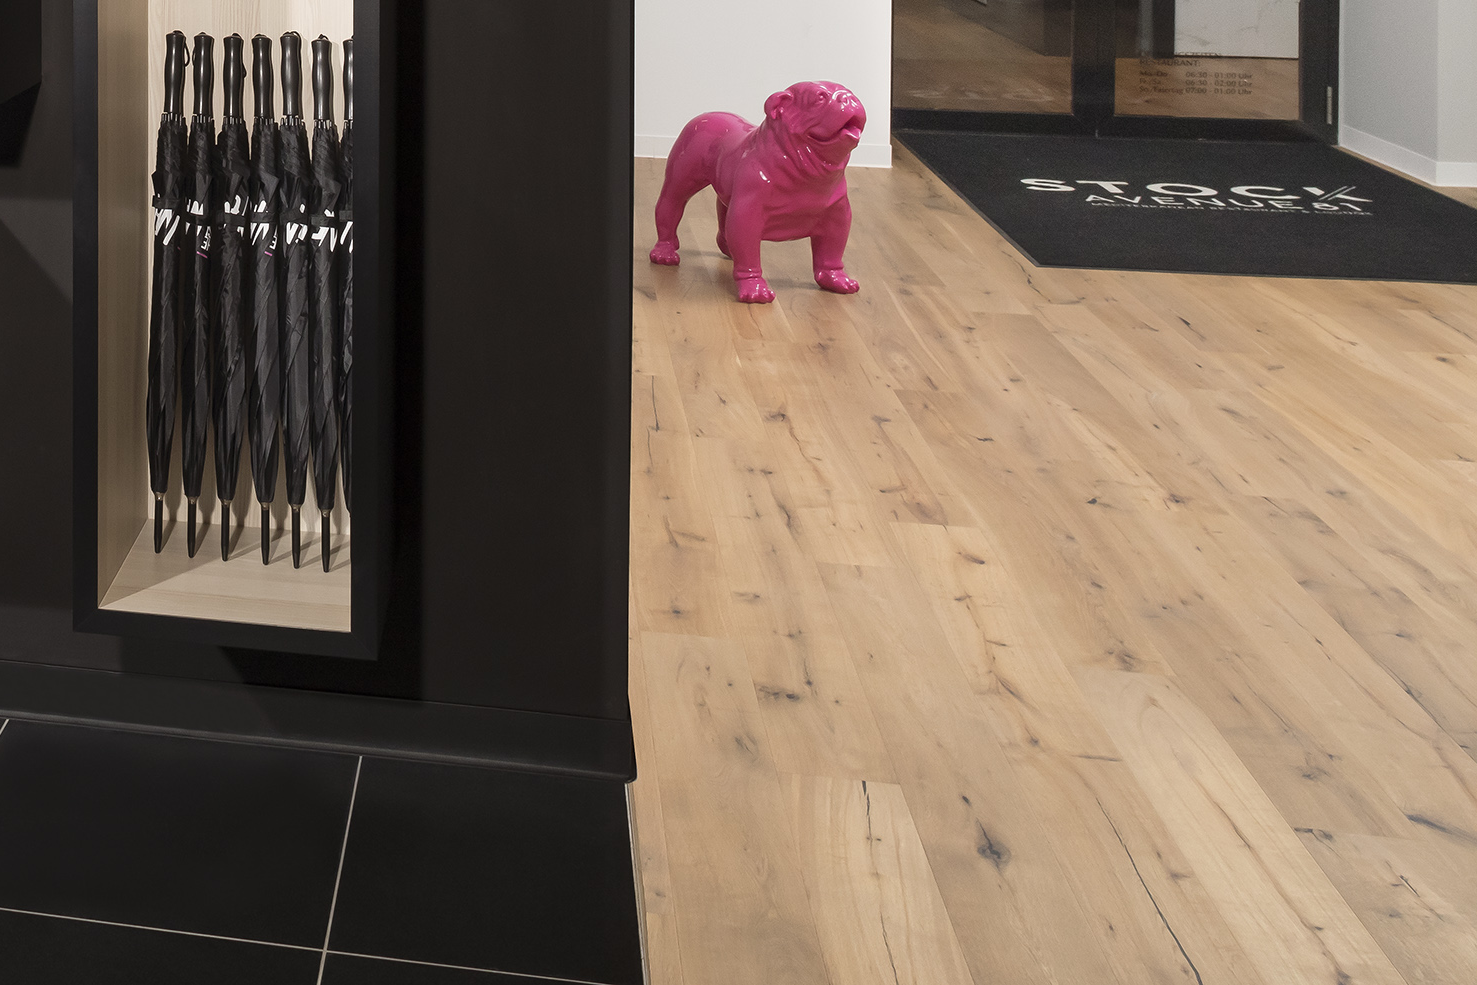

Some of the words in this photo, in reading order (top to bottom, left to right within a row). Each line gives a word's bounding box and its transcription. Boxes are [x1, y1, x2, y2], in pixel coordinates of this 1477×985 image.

[1020, 177, 1373, 203] STOCK
[1085, 194, 1304, 210] AVENUE
[1311, 202, 1363, 212] 81
